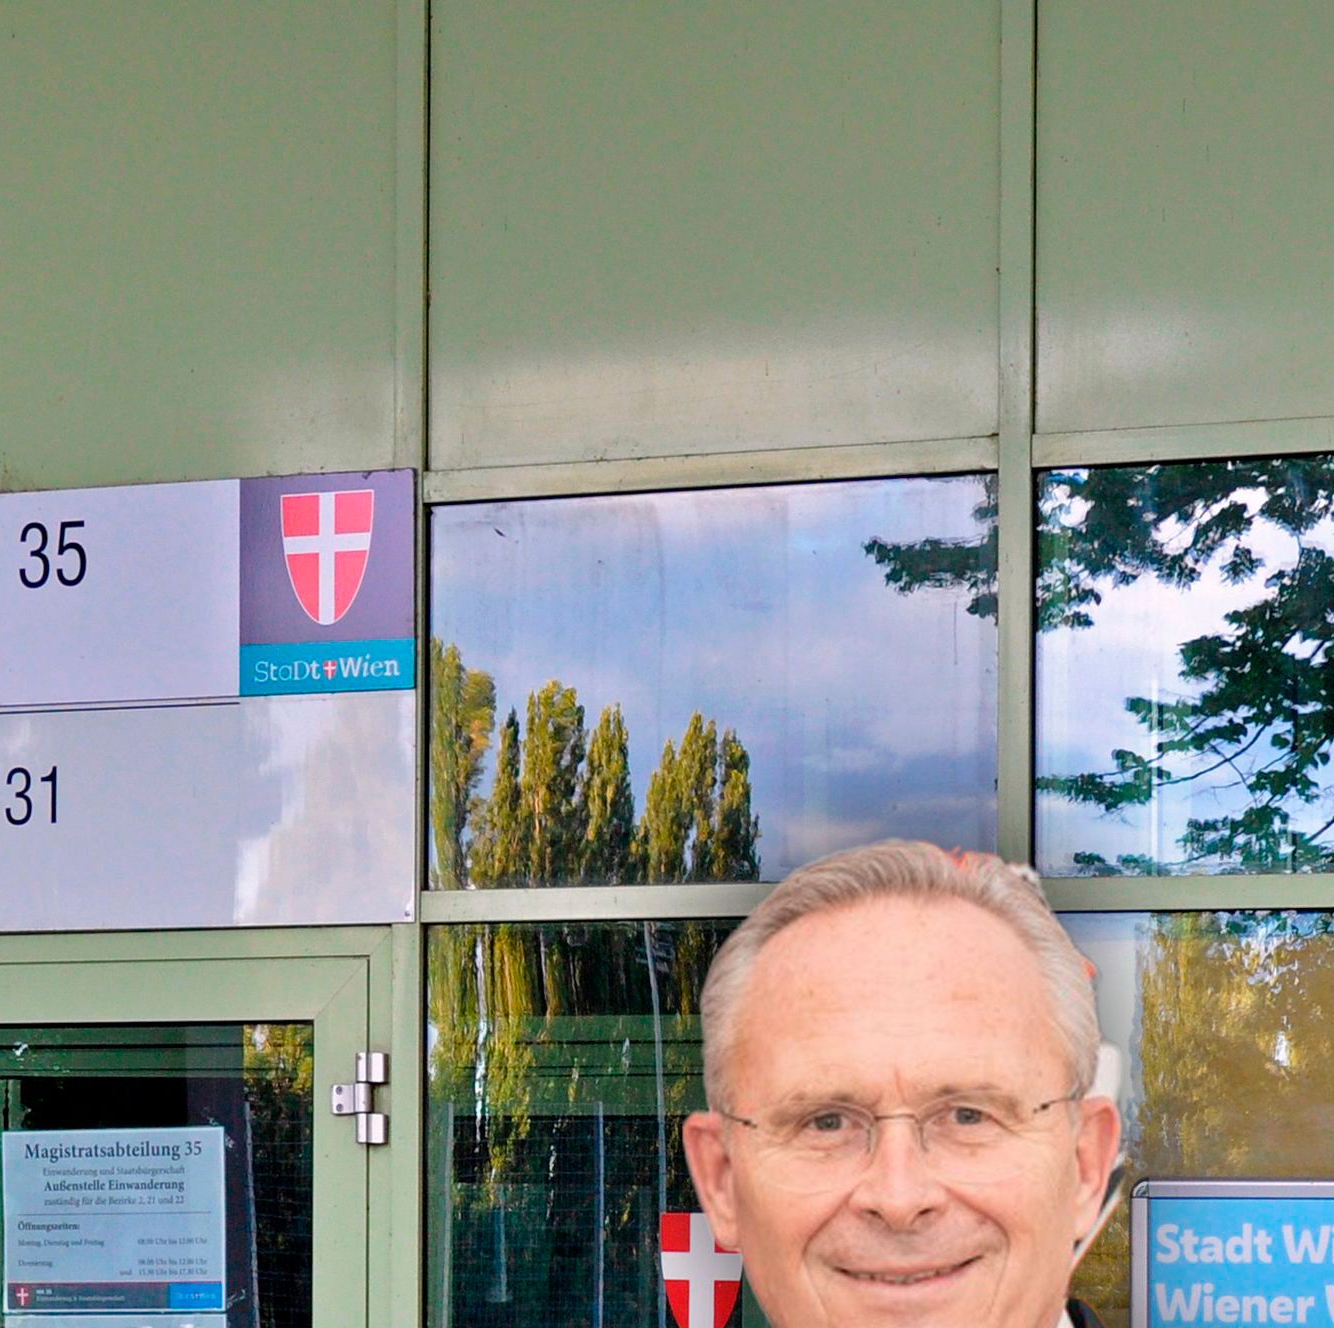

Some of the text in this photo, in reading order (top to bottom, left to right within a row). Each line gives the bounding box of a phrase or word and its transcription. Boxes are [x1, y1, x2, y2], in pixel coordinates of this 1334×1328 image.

[18, 519, 87, 589] 35
[339, 654, 400, 679] Wien
[5, 766, 59, 826] 31
[25, 1141, 203, 1163] Magistratsabteilung 35
[42, 1165, 185, 1178] Einwanderung und Staatsbürgerschaft
[44, 1179, 185, 1192] Außenstelle Einwanderung
[44, 1196, 80, 1208] zuständig
[81, 1195, 93, 1206] für
[95, 1196, 107, 1206] die
[108, 1195, 137, 1205] Bezirke
[157, 1195, 174, 1205] und
[1155, 1223, 1272, 1264] Stadt
[1155, 1283, 1315, 1324] Wiener
